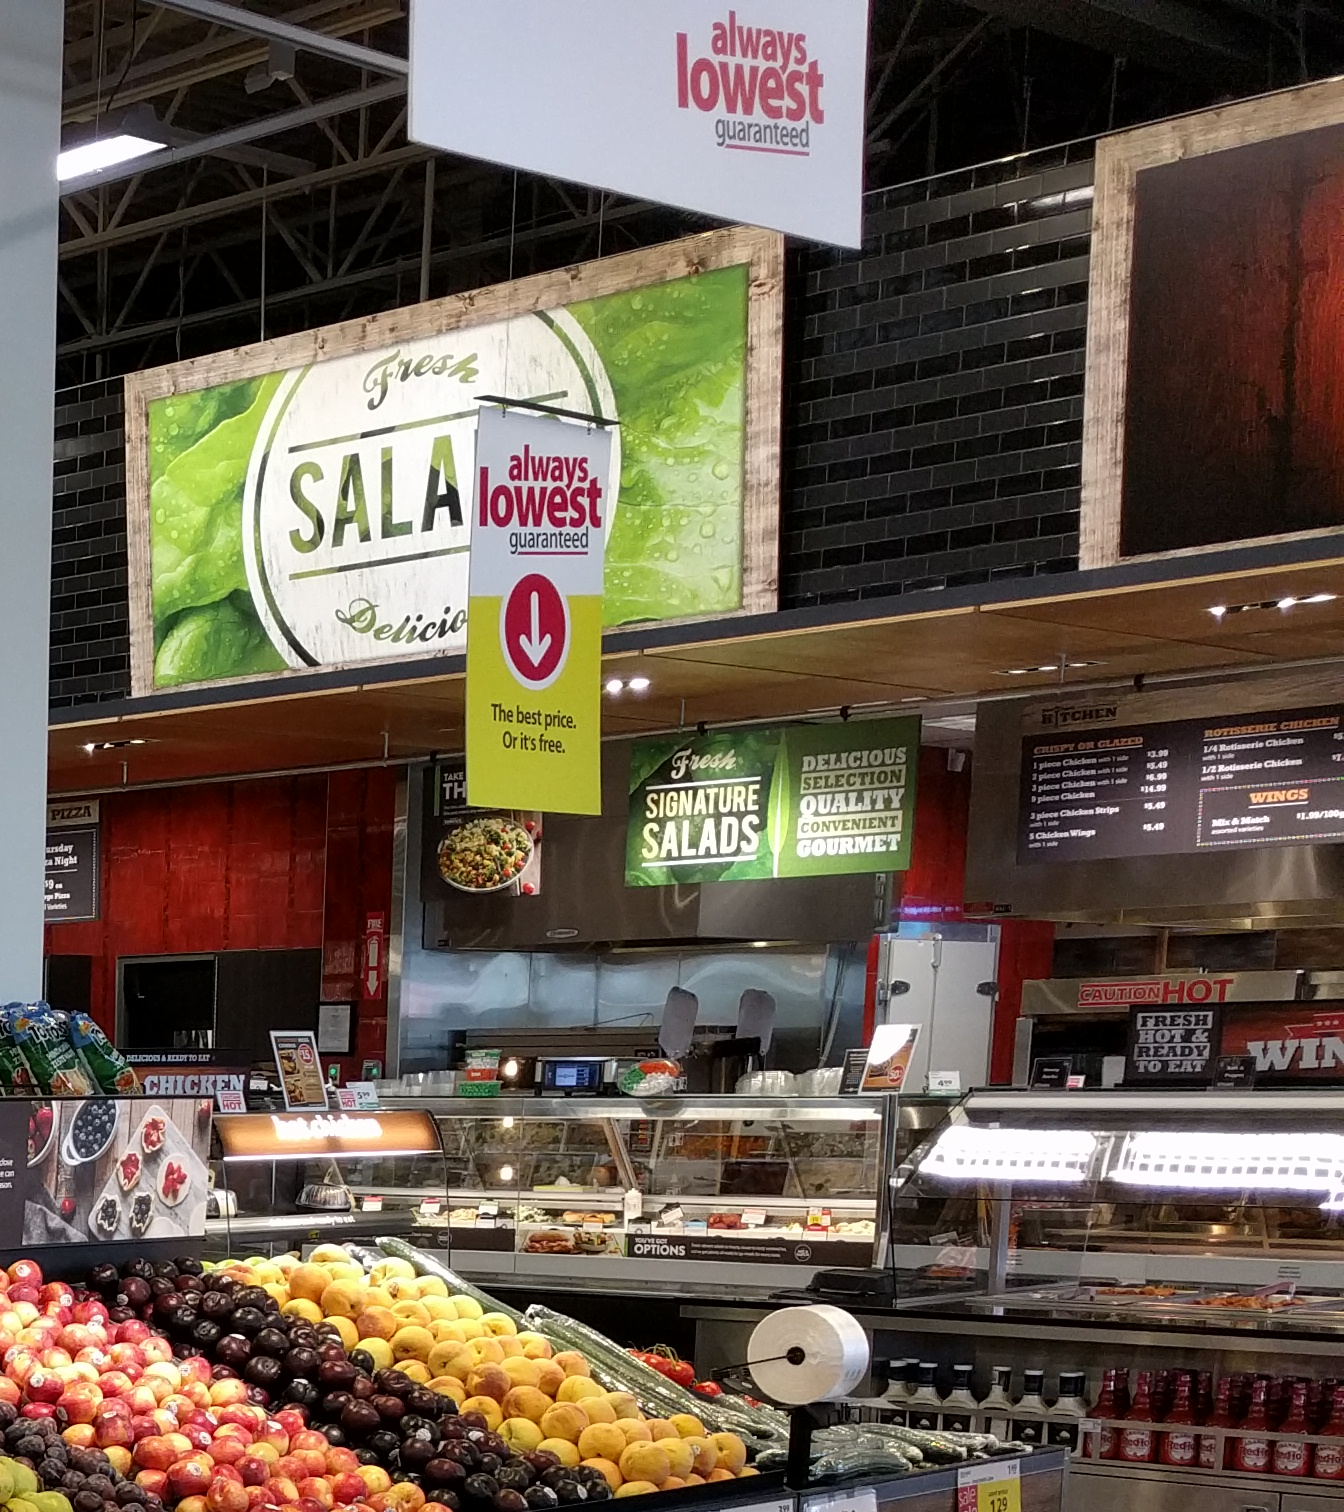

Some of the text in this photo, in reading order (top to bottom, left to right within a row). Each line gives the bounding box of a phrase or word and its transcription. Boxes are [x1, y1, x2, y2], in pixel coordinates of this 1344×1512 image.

[712, 10, 806, 72] always
[676, 32, 824, 124] lowest
[715, 116, 810, 147] guaranteed
[363, 350, 480, 410] Fresh
[509, 445, 589, 484] always
[289, 434, 464, 554] SALA
[479, 466, 603, 529] lowest
[509, 527, 589, 555] guaranteed
[491, 703, 543, 728] The best
[502, 730, 519, 750] Or
[1265, 737, 1304, 747] Chicken
[670, 749, 737, 780] Fresh
[802, 747, 908, 773] DELICIOUS
[802, 768, 903, 791] SELECTION
[645, 784, 760, 819] SIGNATURE
[799, 788, 905, 820] QUALITY
[1249, 788, 1309, 804] WINGS
[51, 805, 92, 821] PIZZA
[800, 815, 898, 833] CONVENIENT
[642, 814, 760, 859] SALADS
[796, 833, 901, 858] GOURMET
[54, 855, 78, 867] Night
[1079, 978, 1235, 1004] CAUTION HOT
[1140, 1014, 1209, 1028] FRESH
[1138, 1029, 1185, 1043] HOT
[1136, 1044, 1208, 1058] READY
[1136, 1059, 1205, 1073] TO EAT
[143, 1074, 245, 1095] CHICKEN
[222, 1098, 242, 1111] HOT
[634, 1243, 686, 1257] OPTIONS
